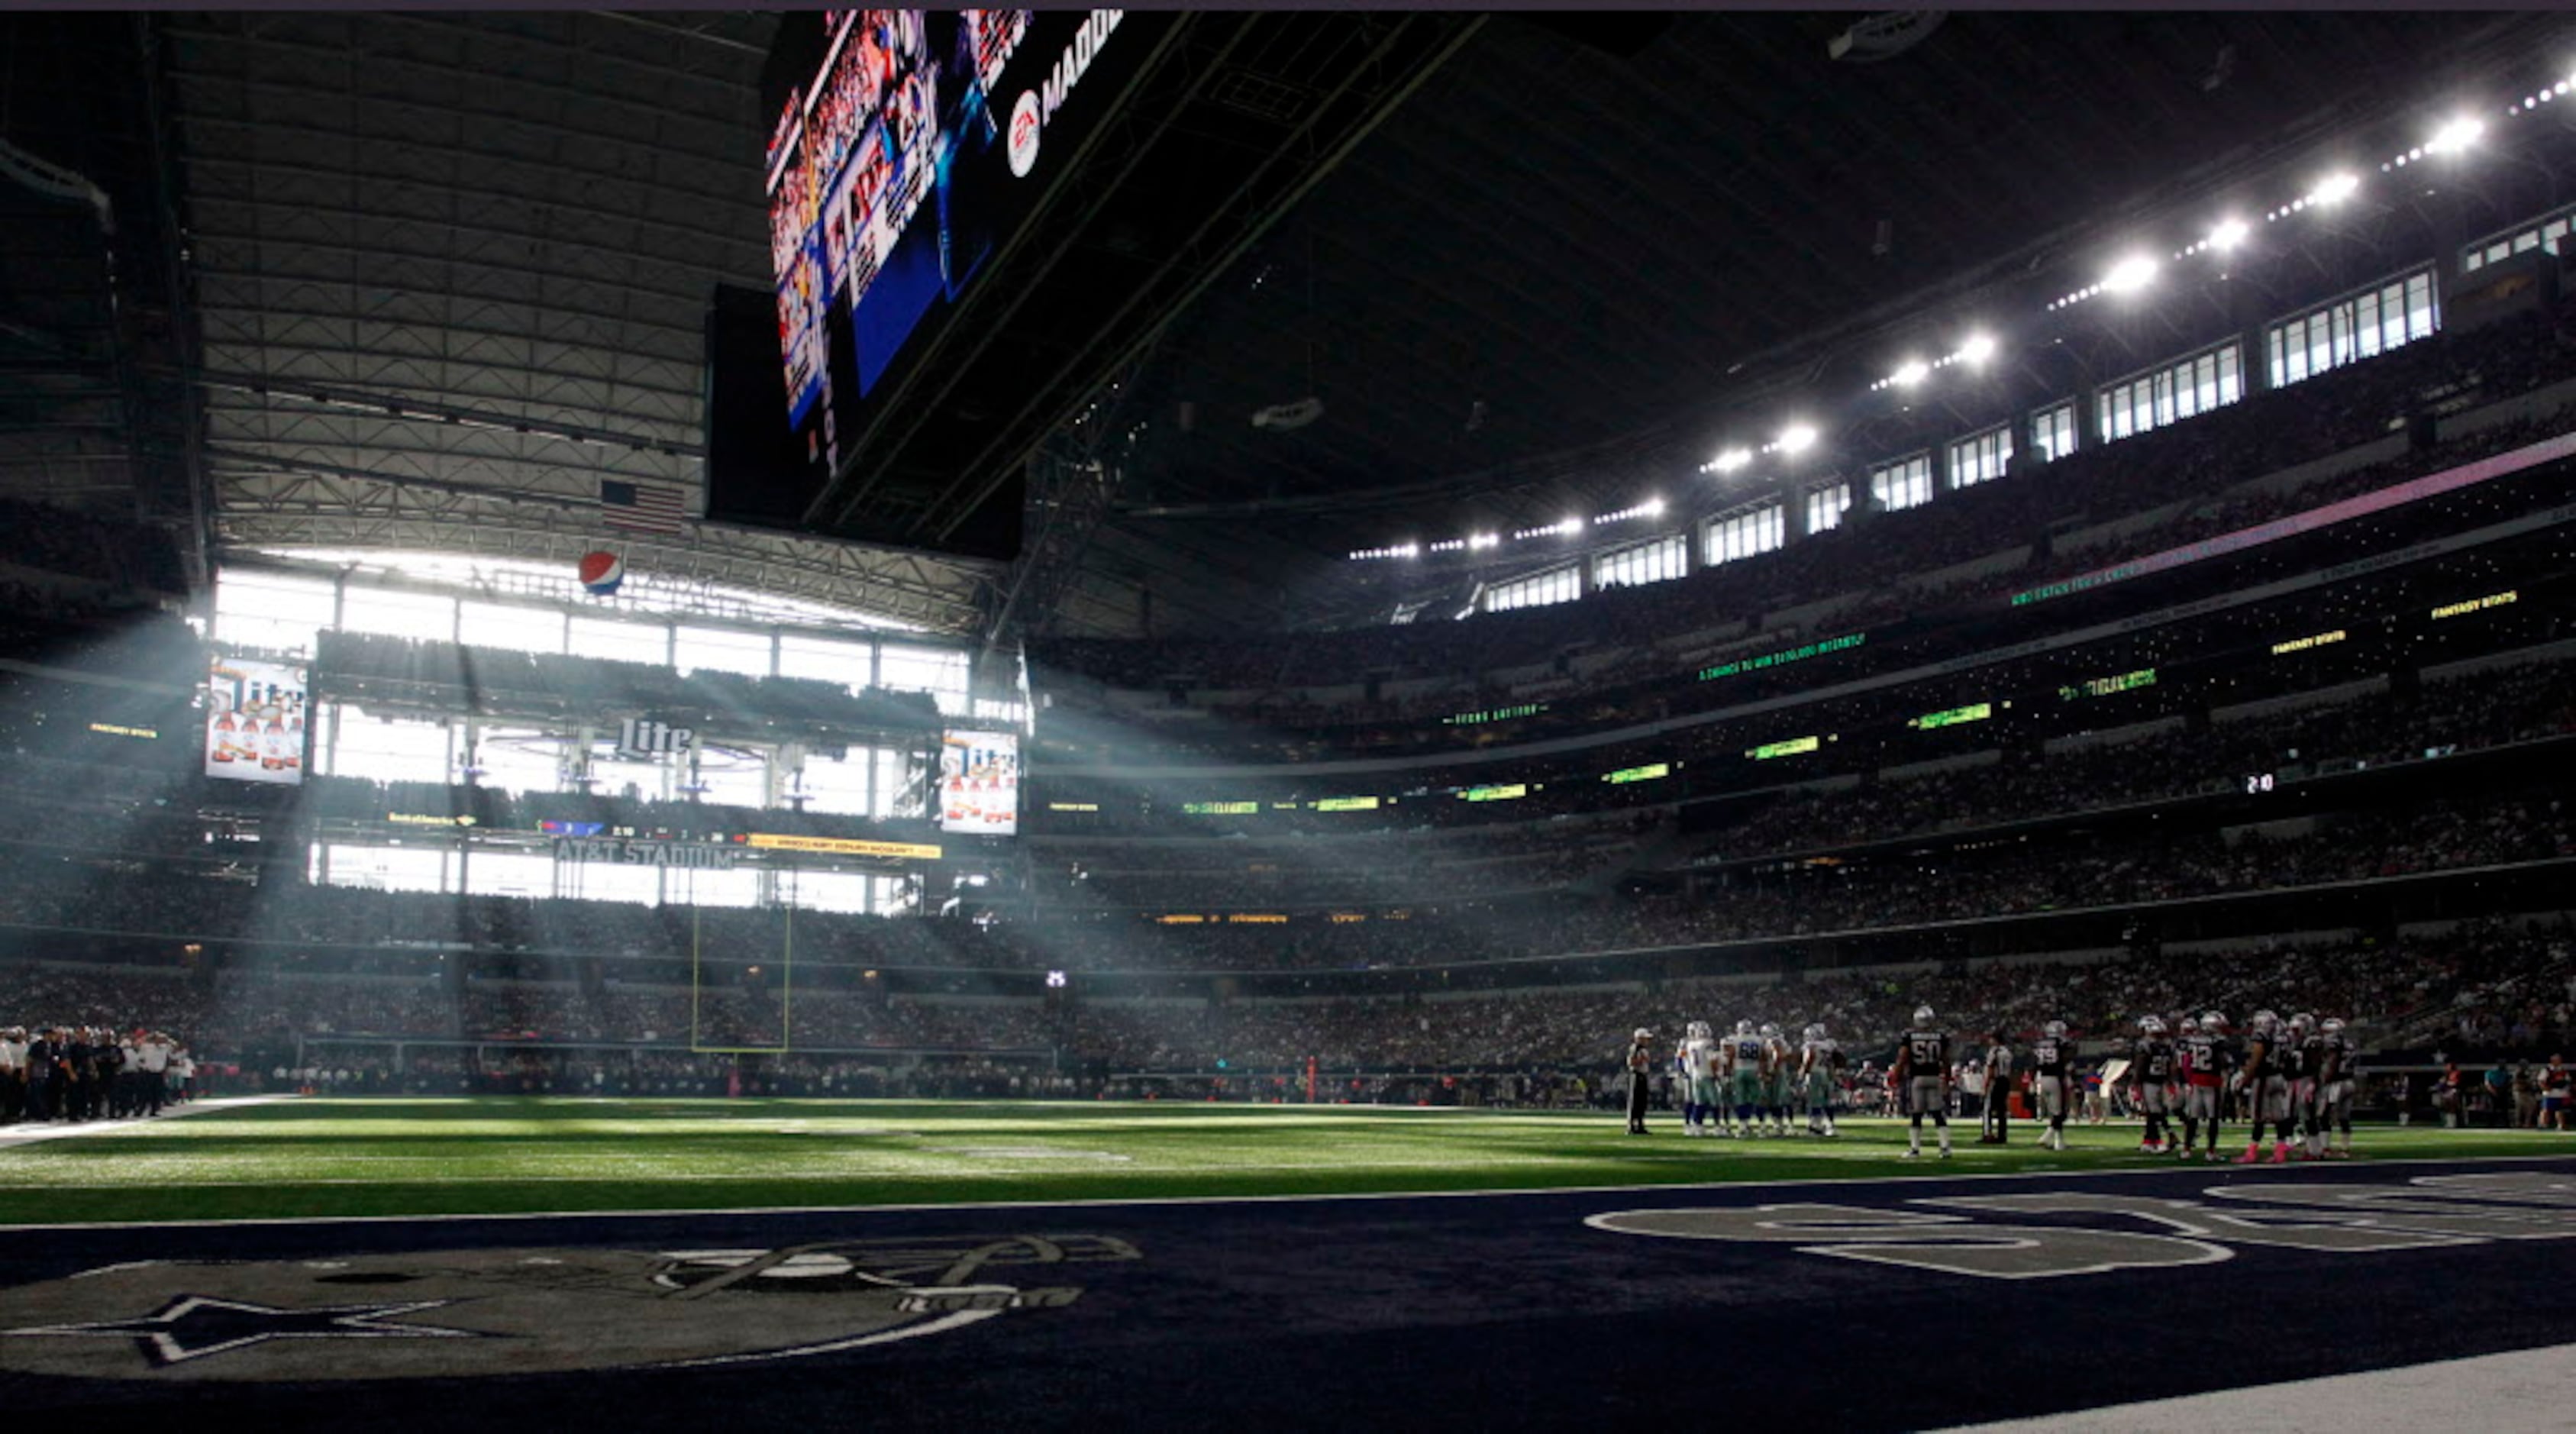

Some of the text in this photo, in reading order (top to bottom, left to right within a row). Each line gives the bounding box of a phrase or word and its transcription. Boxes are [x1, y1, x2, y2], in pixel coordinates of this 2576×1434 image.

[616, 718, 693, 758] Lite
[555, 839, 620, 863] AT&T
[623, 843, 734, 870] STADIUM
[1910, 1040, 1942, 1065] 50
